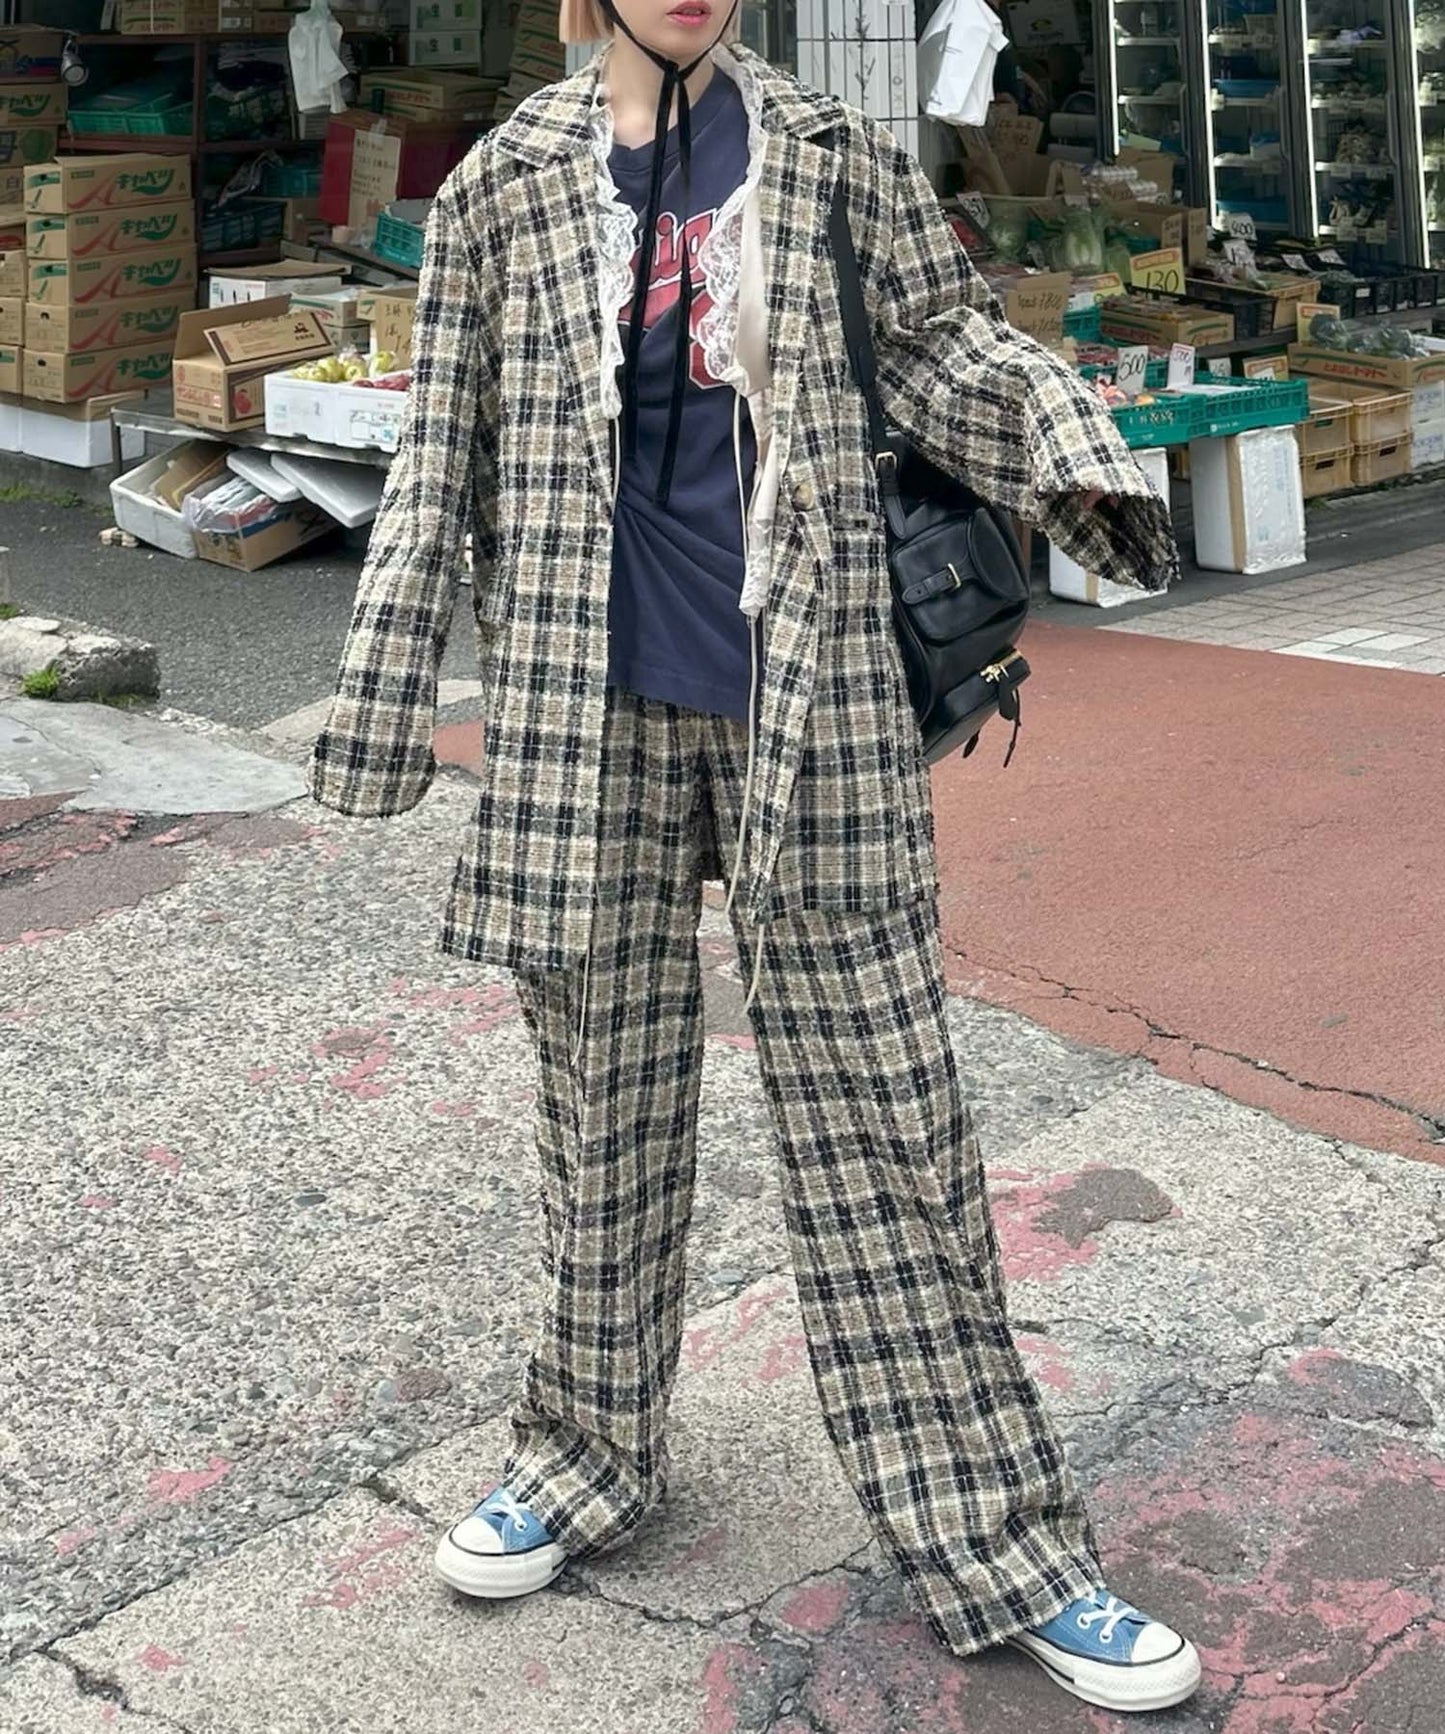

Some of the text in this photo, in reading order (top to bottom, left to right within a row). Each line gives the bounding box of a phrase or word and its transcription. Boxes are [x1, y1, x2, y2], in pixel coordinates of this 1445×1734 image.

[115, 168, 176, 195] キャベツ
[120, 213, 178, 240] キャベツ
[122, 258, 182, 286] キャベツ
[1144, 268, 1179, 295] 130
[119, 305, 179, 333] キャベツ
[1118, 353, 1146, 382] 500
